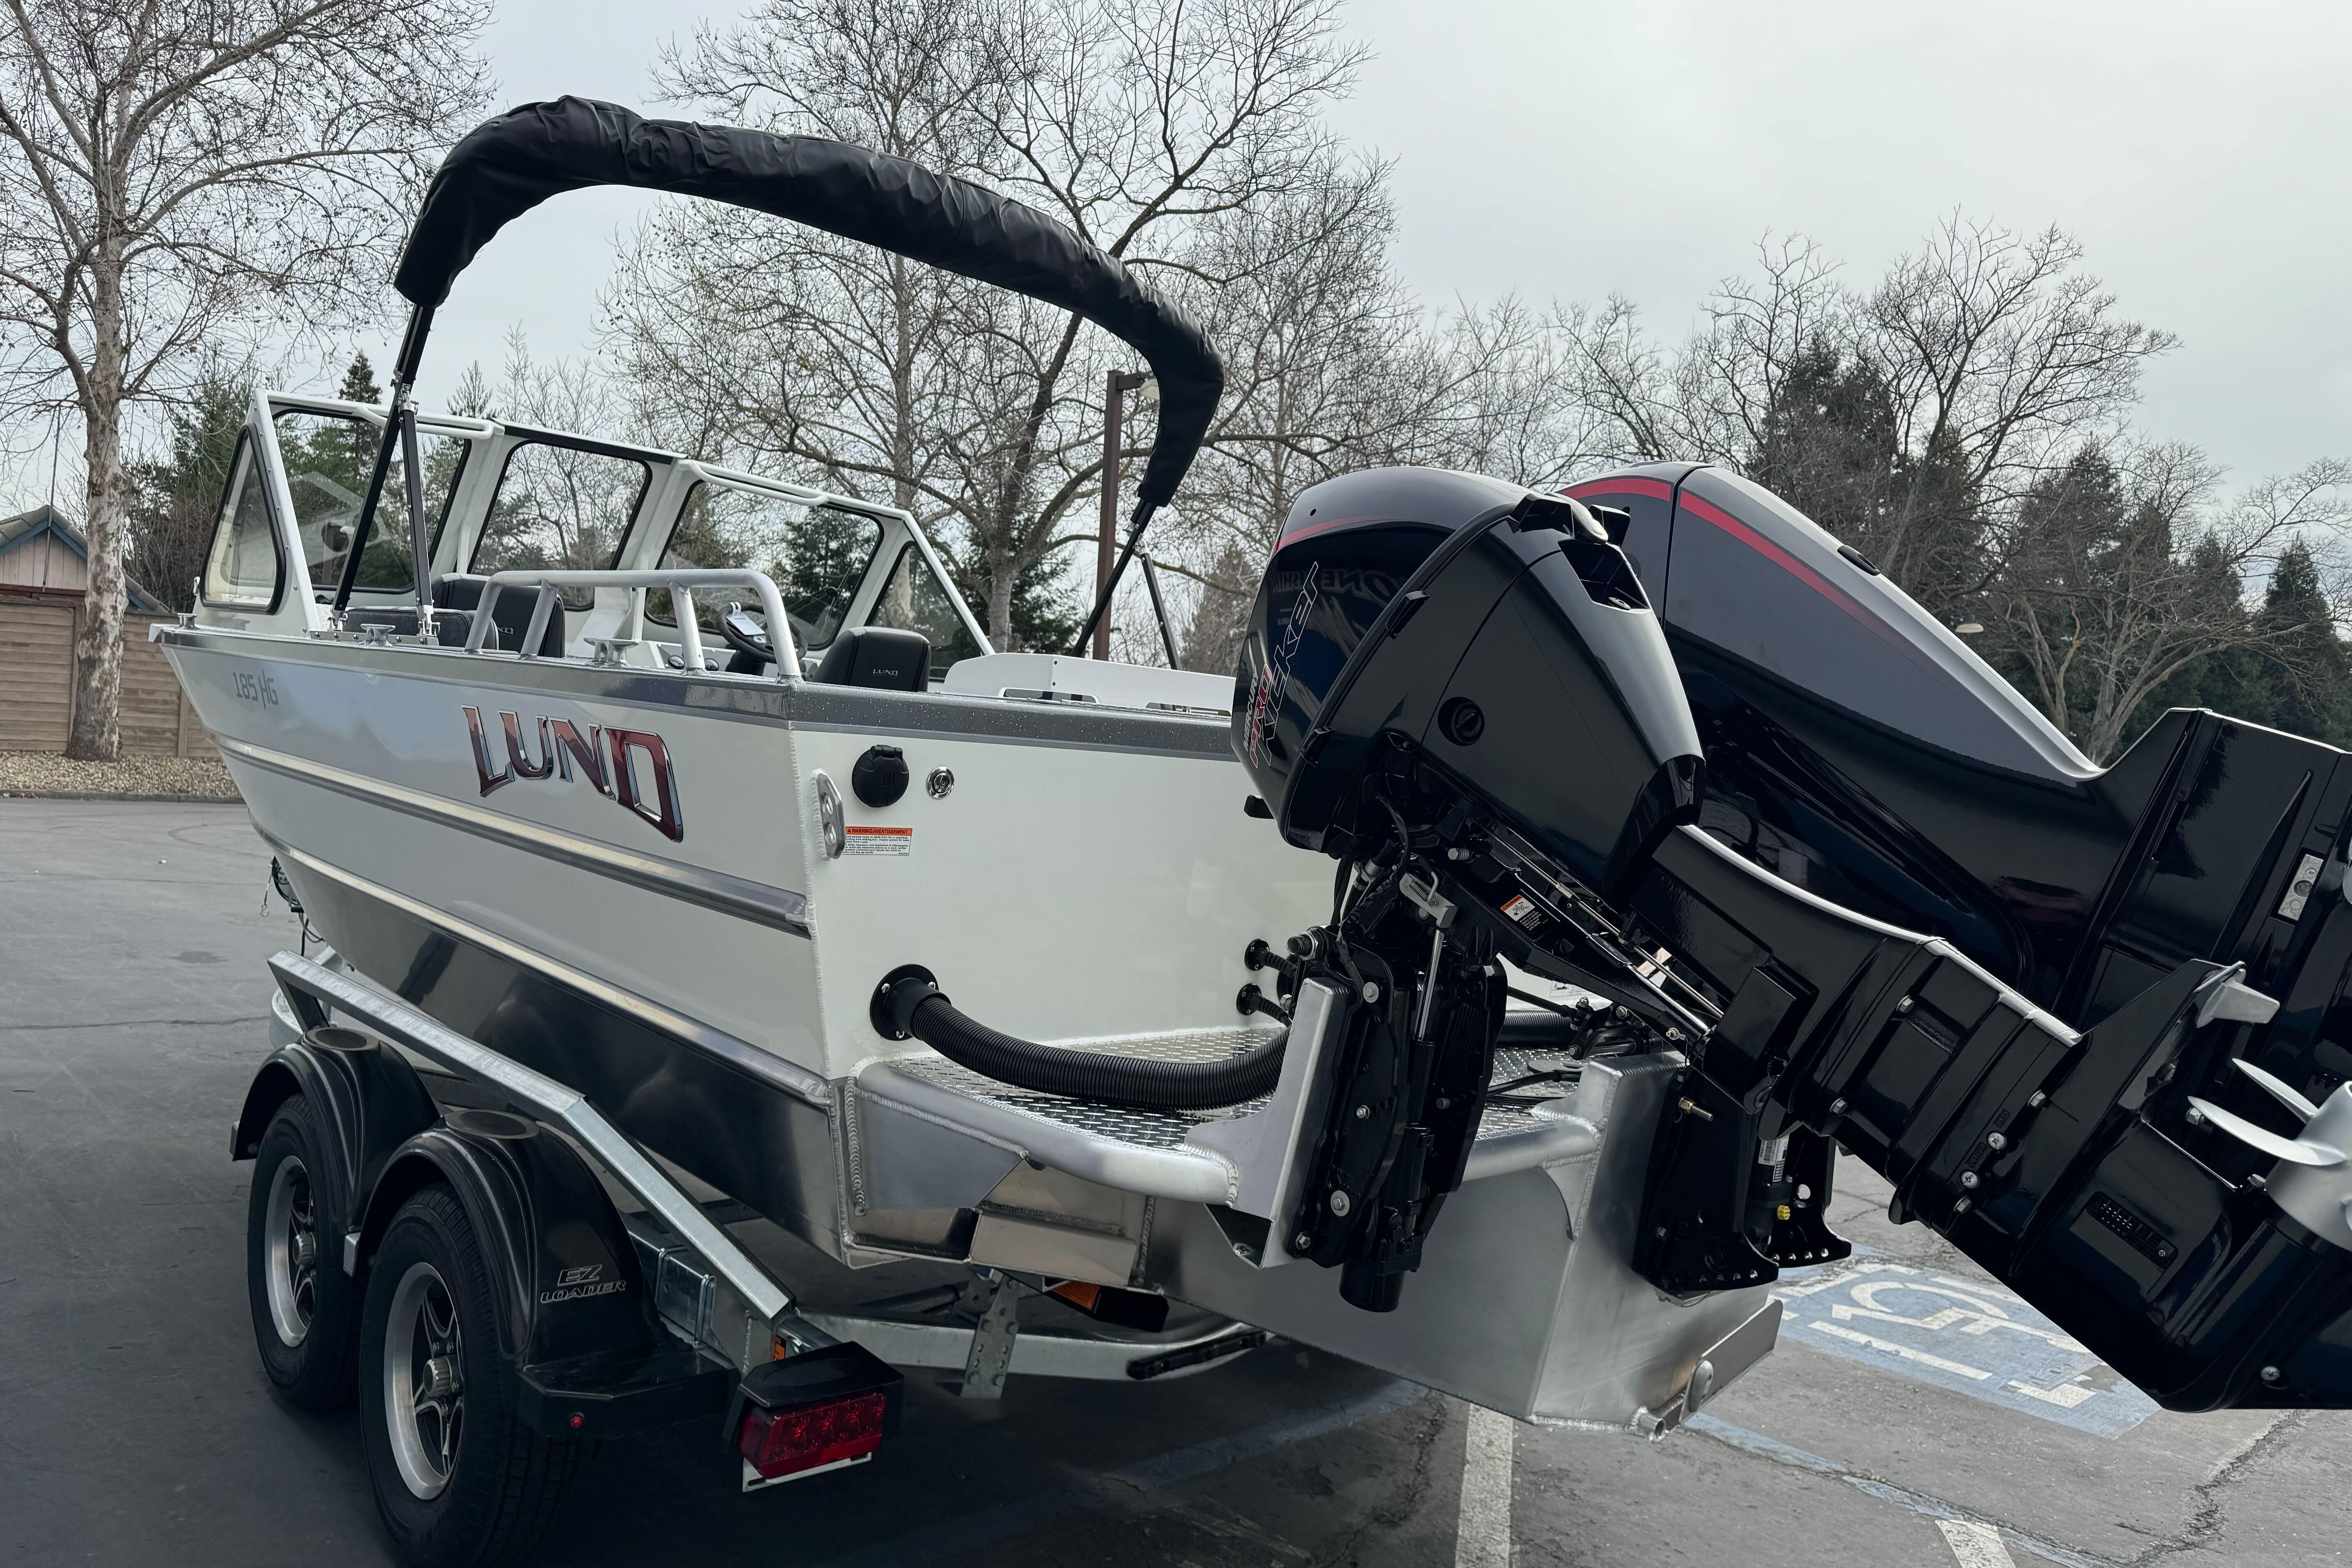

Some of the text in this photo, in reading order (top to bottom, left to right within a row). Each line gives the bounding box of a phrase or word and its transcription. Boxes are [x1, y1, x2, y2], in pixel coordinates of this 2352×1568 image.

[233, 668, 279, 711] 185 HG
[1243, 663, 1259, 752] MERCURY
[1250, 663, 1273, 769] PRO
[461, 705, 684, 843] LUND
[540, 1280, 626, 1304] LOADER
[557, 1265, 602, 1287] EZ
